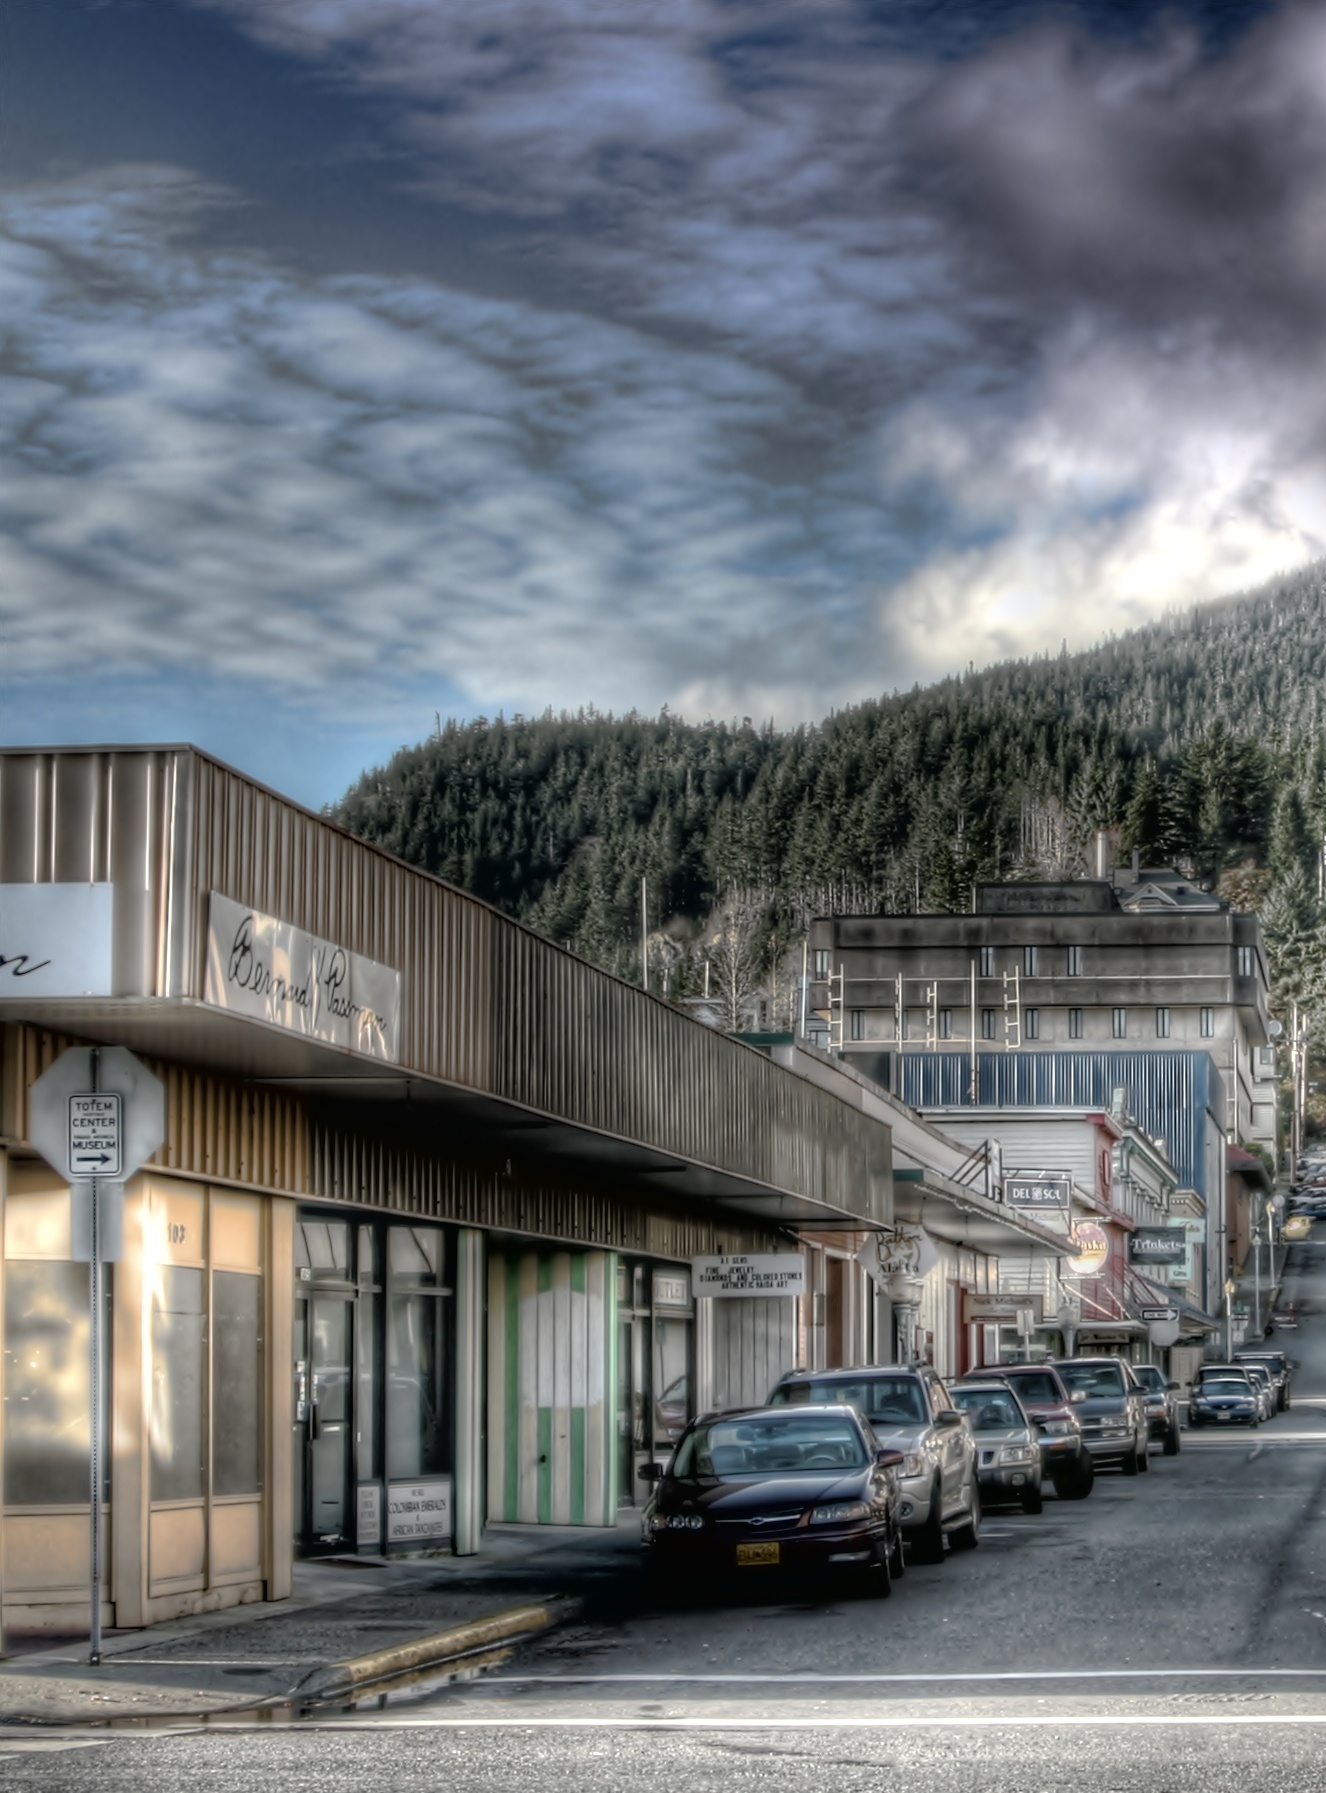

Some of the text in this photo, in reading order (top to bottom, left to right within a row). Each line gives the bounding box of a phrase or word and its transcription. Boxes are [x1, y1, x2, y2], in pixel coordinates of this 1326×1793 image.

[76, 1102, 112, 1111] TOTEM
[72, 1118, 116, 1127] CENTER
[72, 1140, 116, 1150] MUSEUM
[1012, 1188, 1061, 1200] DEL SOL
[167, 1223, 185, 1244] 103
